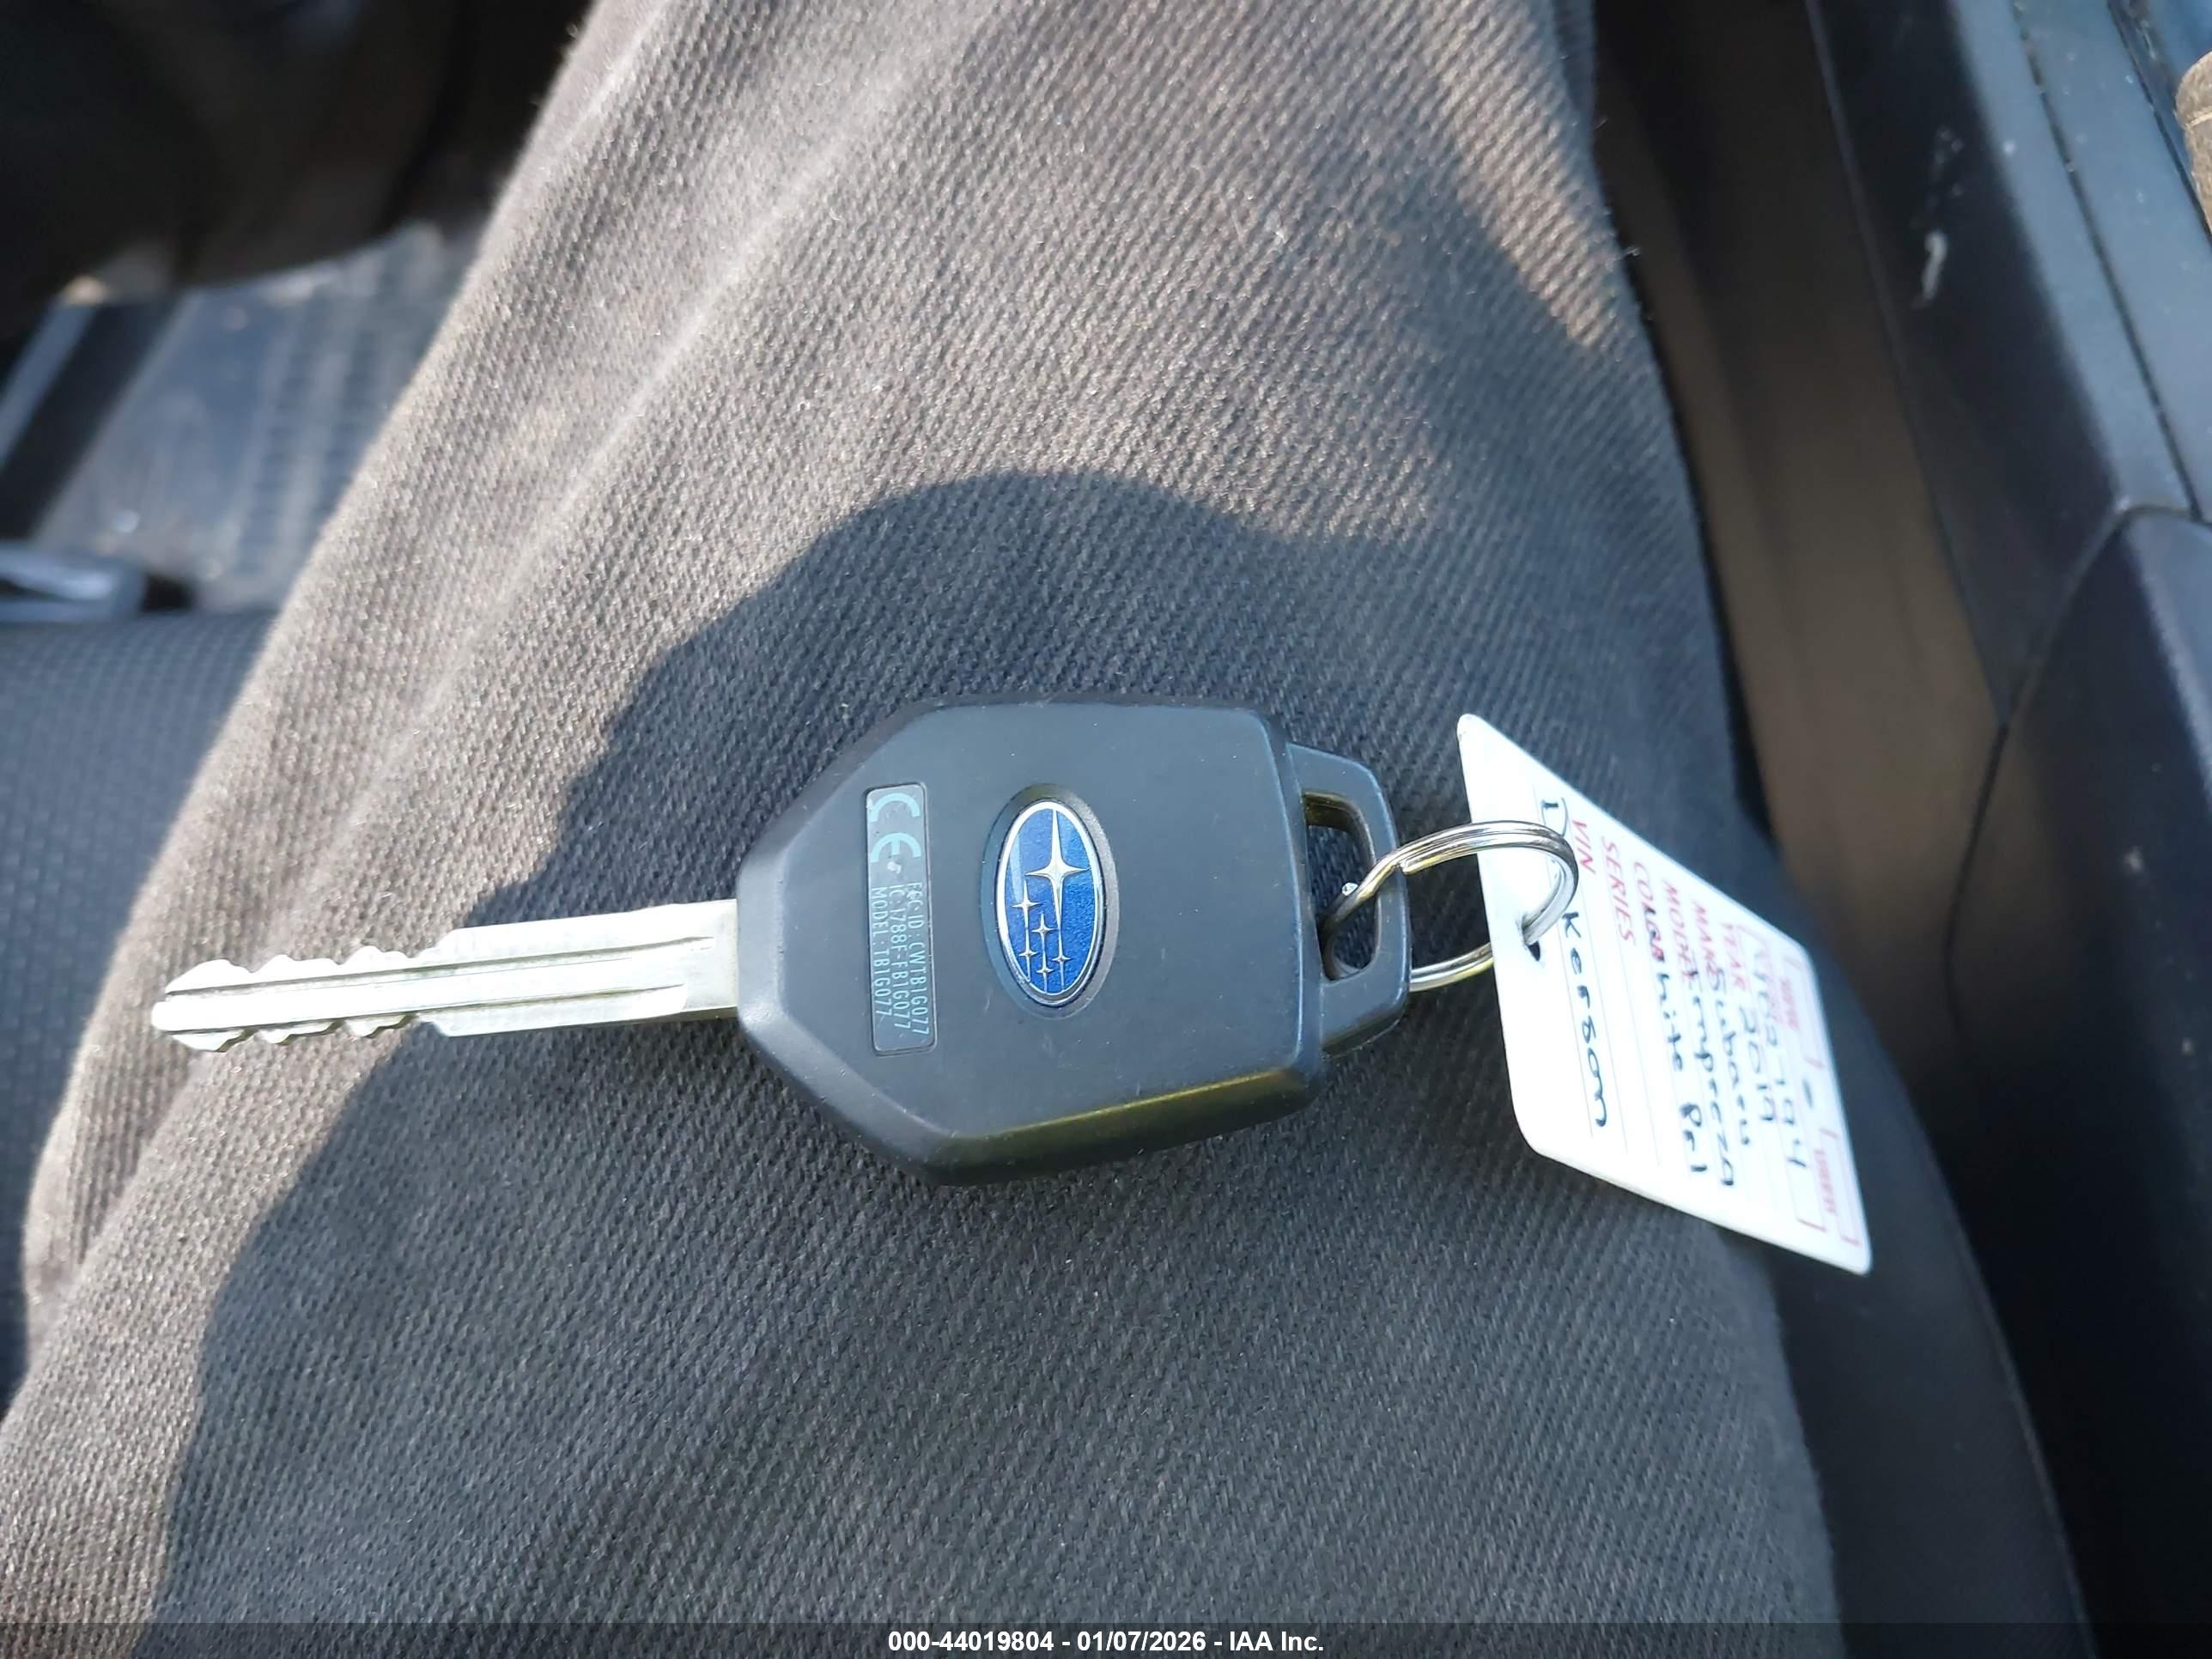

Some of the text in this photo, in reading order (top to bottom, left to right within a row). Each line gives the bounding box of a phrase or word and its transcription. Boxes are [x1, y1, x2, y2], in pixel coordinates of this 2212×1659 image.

[906, 882, 923, 908] FCC
[1572, 820, 1596, 875] VIN
[1601, 836, 1636, 946] SERIES
[1689, 950, 1735, 1187] Impreza
[1708, 960, 1751, 1146] Subaru
[1739, 1006, 1776, 1121] 2019
